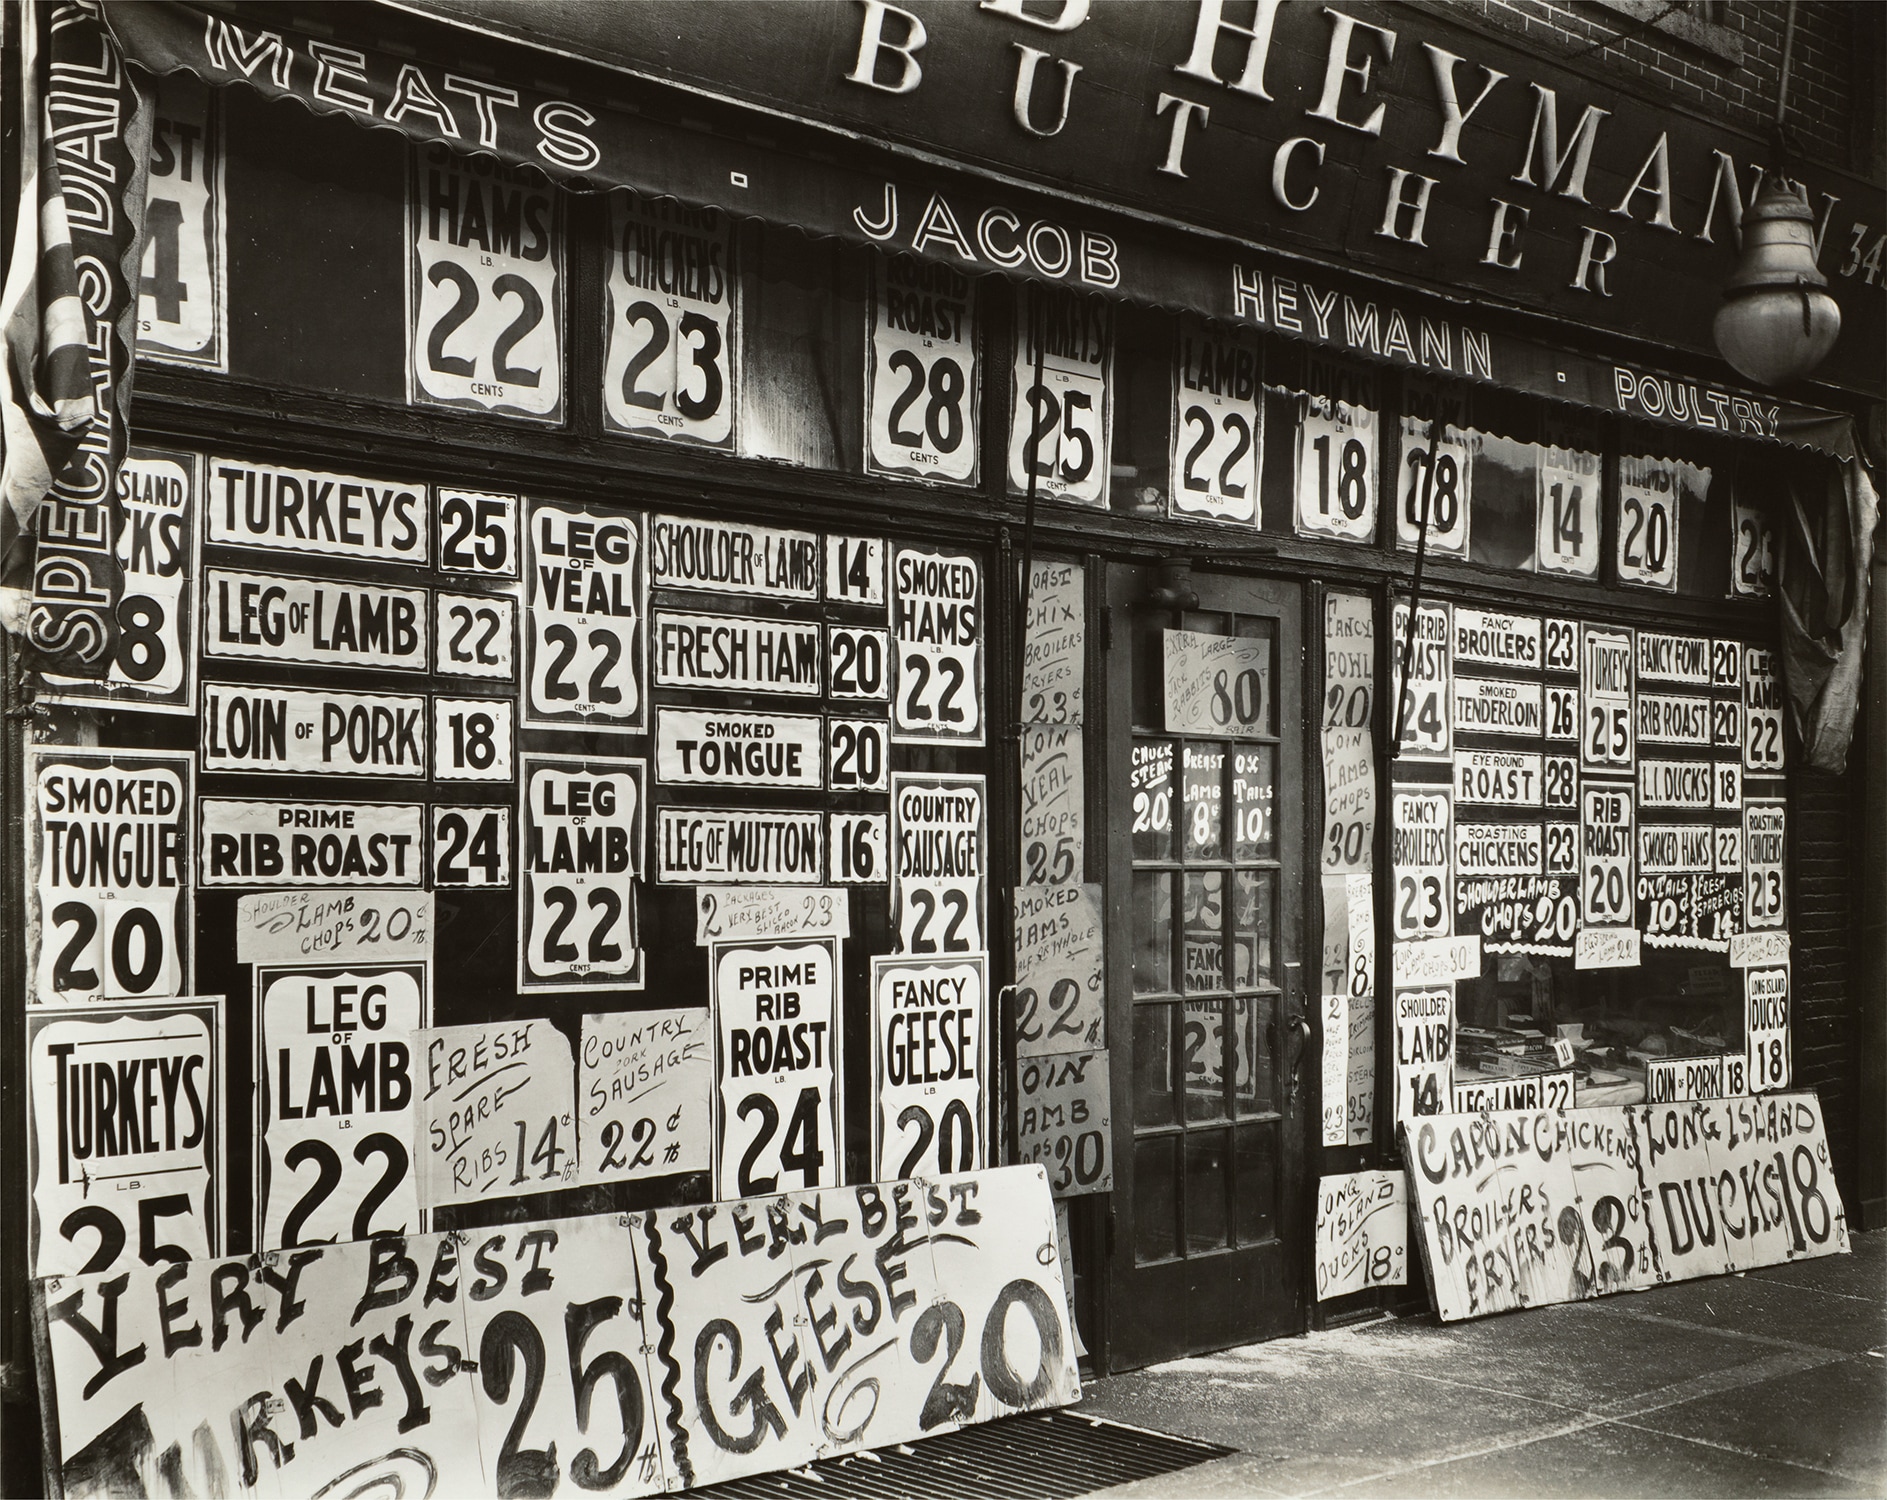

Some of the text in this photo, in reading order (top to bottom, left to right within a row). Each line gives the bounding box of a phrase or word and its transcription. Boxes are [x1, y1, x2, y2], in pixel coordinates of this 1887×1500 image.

[206, 13, 601, 171] MEATS
[845, 0, 1618, 297] BUTCHER
[427, 170, 552, 262] HAMS
[853, 182, 1120, 289] JACOB
[620, 220, 725, 305] CHICKENS
[427, 260, 543, 388] 22
[886, 296, 964, 344] ROAST
[1233, 264, 1493, 381] HEYMANN
[621, 300, 722, 420] 23
[887, 349, 965, 448] 28
[1613, 367, 1781, 440] POULTRY
[1022, 384, 1094, 483] 25
[1184, 405, 1251, 499] 22
[1313, 434, 1367, 520] 18
[217, 467, 418, 552] TURKEYS
[1550, 482, 1584, 557] 14
[541, 516, 631, 566] LEG
[655, 522, 817, 592] SHOULDER OF LAMB
[1624, 497, 1669, 572] 20
[568, 557, 594, 571] OF
[899, 556, 975, 602] SMOKED
[539, 566, 633, 617] VEAL
[218, 580, 419, 656] LEG OF LAMB
[899, 600, 976, 648] HAMS
[1325, 598, 1373, 639] FANCY
[1481, 616, 1515, 631] FANCY
[543, 624, 622, 704] 22
[661, 623, 816, 685] FRESH HAM
[1024, 634, 1082, 668] BROILERS
[1201, 636, 1237, 660] LARGE
[1327, 651, 1373, 680] FOWL
[1458, 627, 1537, 662] BROILERS
[1587, 637, 1630, 699] TURKEYS
[1639, 636, 1708, 676] FANCY FOWL
[905, 653, 965, 722] 22
[1023, 667, 1072, 693] FRYERS
[1172, 666, 1212, 716] RABBITS
[1478, 685, 1518, 699] SMOKED
[208, 694, 424, 767] LOIN OF PORK
[705, 720, 775, 740] SMOKED
[1457, 695, 1538, 728] TENDERLOIN
[1590, 706, 1628, 757] 25
[1640, 699, 1708, 739] RIB ROAST
[676, 739, 803, 778] TONGUE
[1022, 726, 1069, 769] LOIN
[1132, 743, 1174, 766] CHUCK
[1183, 748, 1226, 771] BREAST
[1472, 754, 1525, 769] EYE ROUND
[1750, 716, 1779, 763] 22
[44, 776, 177, 816] SMOKED
[1023, 765, 1073, 814] VEAL
[1131, 758, 1174, 789] STEAK
[1183, 775, 1222, 803] LAMB
[1233, 778, 1273, 804] TAILS
[1325, 758, 1369, 796] LAMB
[1462, 767, 1534, 801] ROAST
[1664, 766, 1709, 802] DUCKS
[278, 809, 355, 829] PRIME
[542, 779, 616, 817] LEG
[571, 815, 587, 826] OF
[902, 795, 976, 824] COUNTRY
[1328, 786, 1371, 815] CHOPS
[1402, 801, 1439, 824] FANCY
[1592, 796, 1622, 824] RIB
[665, 815, 817, 874] LEG MUTTON
[1023, 811, 1079, 838] CHOPS
[1468, 827, 1528, 840] ROASTING
[1584, 825, 1630, 858] ROAST
[1749, 814, 1783, 832] ROASTING
[45, 821, 187, 888] TONGUE
[211, 833, 413, 878] RIB ROAST
[532, 826, 630, 874] LAMB
[902, 829, 977, 878] SAUSAGE
[1394, 828, 1445, 867] BROILERS
[1458, 841, 1539, 868] CHICKENS
[1642, 831, 1709, 867] SMOKED HAMS
[242, 892, 312, 924] SHOULDER
[1400, 875, 1443, 929] 23
[1456, 876, 1561, 915] SHOULDER LAMB
[1590, 864, 1624, 914] 20
[1697, 874, 1727, 901] FRESH
[1751, 870, 1782, 917] 23
[295, 896, 355, 934] LAMB
[300, 921, 354, 954] CHOPS
[543, 885, 622, 963] 22
[701, 891, 775, 939] 2 PACKAGES
[728, 901, 781, 928] VERY BEST
[910, 888, 969, 954] 22
[1481, 901, 1534, 941] CHOPS
[52, 901, 164, 994] 20
[1052, 927, 1095, 955] WHOLE
[739, 961, 817, 991] PRIME
[892, 976, 967, 1010] FANCY
[1751, 977, 1786, 996] LONG ISLAND
[306, 985, 388, 1033] LEG
[756, 991, 800, 1021] RIB
[1400, 996, 1447, 1018] SHOULDER
[1752, 995, 1787, 1031] DUCKS
[331, 1032, 353, 1046] OF
[423, 1022, 535, 1102] FRESH
[583, 1012, 694, 1071] COUNTRY
[730, 1021, 827, 1079] ROAST
[886, 1009, 975, 1087] GEESE
[1399, 1022, 1449, 1065] LAMB
[1757, 1039, 1784, 1085] 18
[278, 1040, 412, 1121] LAMB
[589, 1042, 704, 1116] SAUSAGE
[1650, 1064, 1720, 1103] LOIN PORK
[47, 1042, 204, 1184] TURKEYS
[429, 1082, 507, 1161] SPARE
[1645, 1101, 1816, 1167] LONG ISLAND
[737, 1086, 824, 1196] 24
[896, 1098, 974, 1182] 20
[1053, 1130, 1104, 1191] 30
[281, 1131, 411, 1250] 22
[452, 1142, 508, 1193] RIBS
[670, 1179, 984, 1278] VERY BEST
[1330, 1182, 1394, 1242] ISLAND
[1433, 1181, 1551, 1266] BROILERS
[1658, 1158, 1784, 1256] DUCKS
[58, 1193, 194, 1276] 25
[1318, 1230, 1369, 1296] DUCKS
[47, 1229, 559, 1401] VERY BEST
[694, 1253, 918, 1455] GEESE
[909, 1278, 1063, 1432] 20
[480, 1296, 645, 1500] 25
